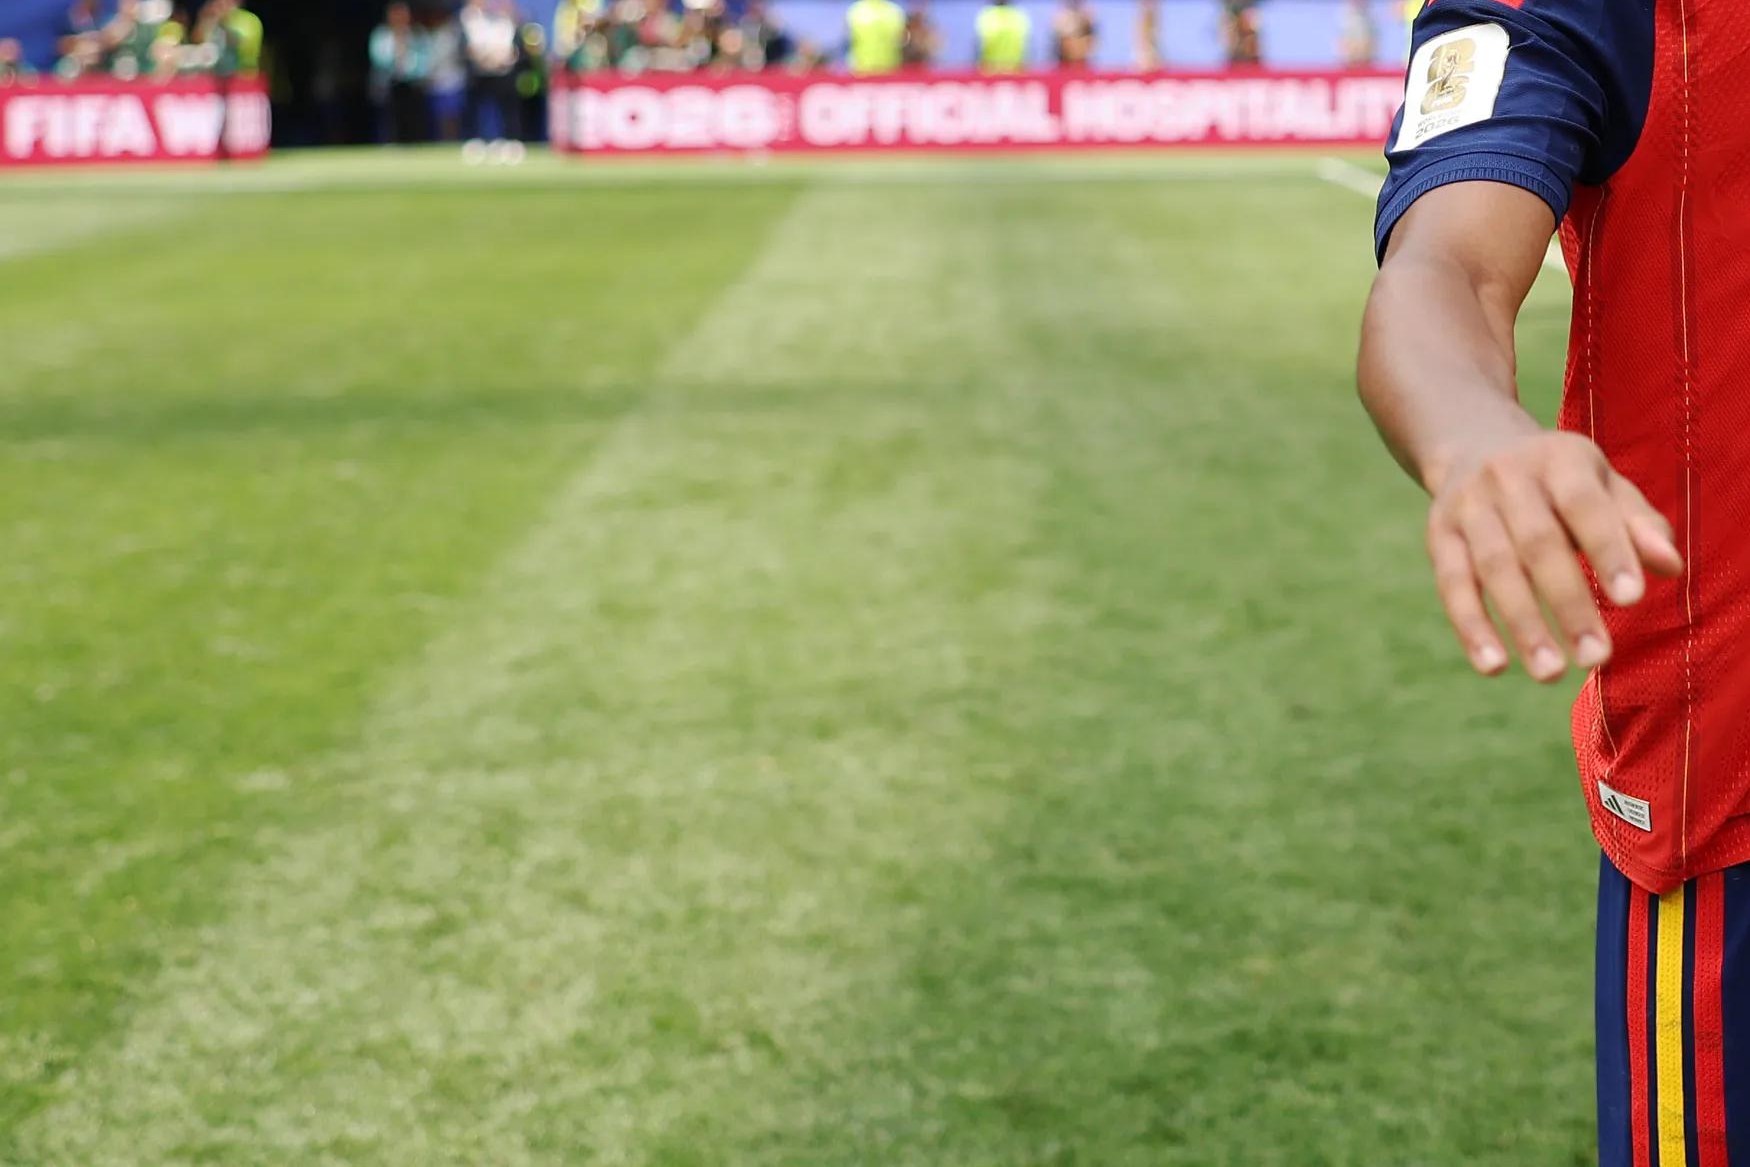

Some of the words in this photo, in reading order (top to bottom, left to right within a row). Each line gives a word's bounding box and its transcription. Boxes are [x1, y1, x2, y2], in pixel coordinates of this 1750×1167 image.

[4, 94, 157, 158] FIFA
[801, 81, 1061, 146] OFFICIAL
[1061, 78, 1403, 143] HOSPITALIT
[1415, 115, 1459, 139] 2026
